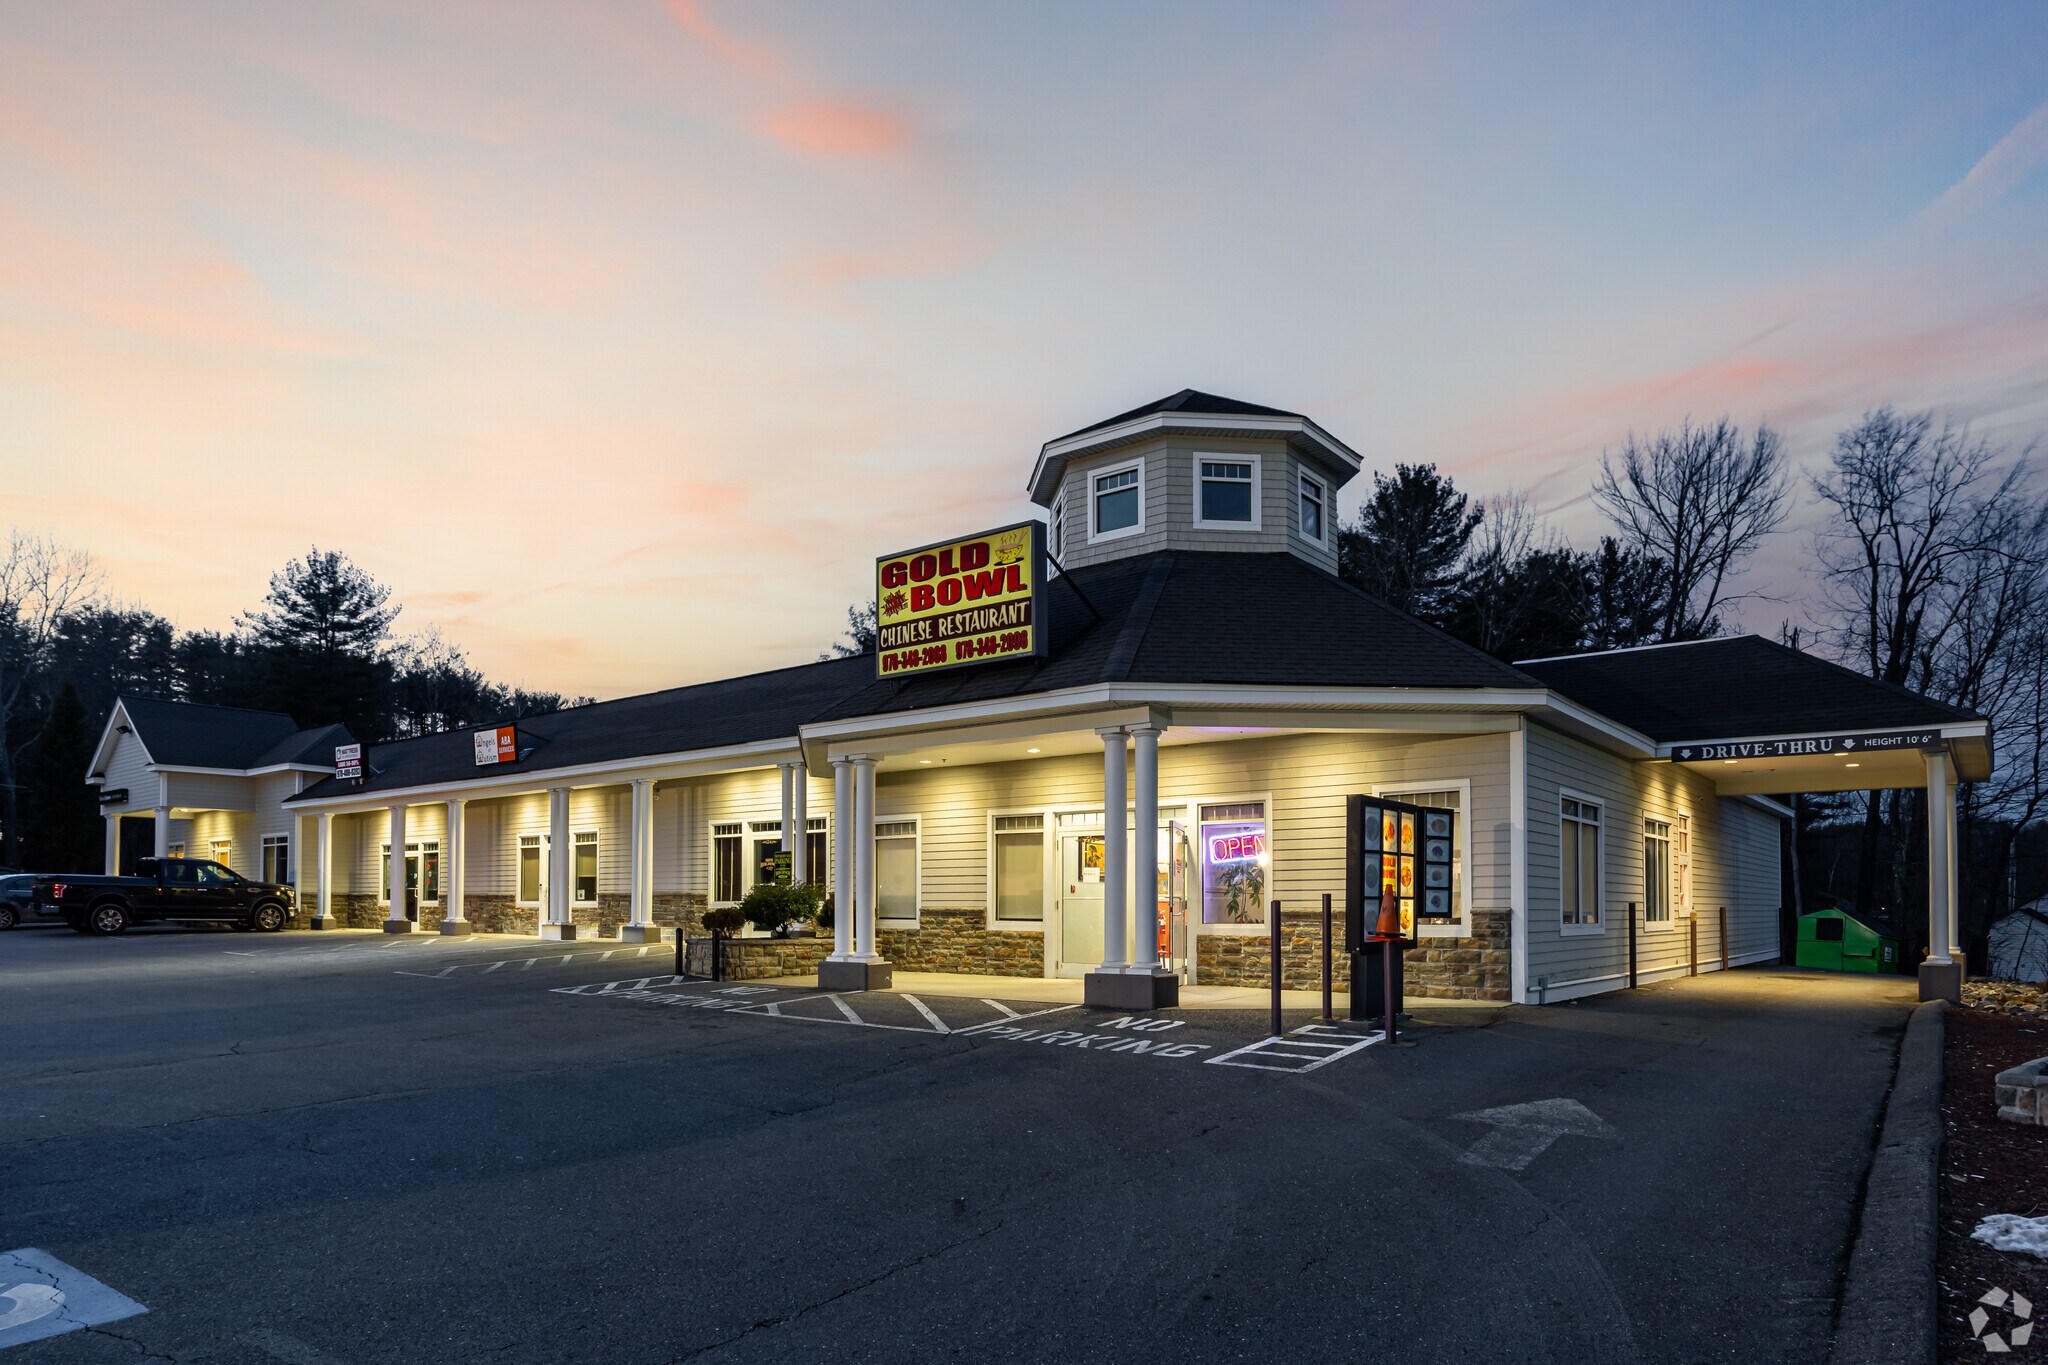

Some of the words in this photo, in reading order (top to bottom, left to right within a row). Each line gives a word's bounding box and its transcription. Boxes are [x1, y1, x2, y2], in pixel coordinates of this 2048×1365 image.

[881, 543, 990, 589] GOLD
[910, 564, 1028, 612] BOWL
[880, 619, 933, 648] CHINESE
[938, 601, 1030, 638] RESTAURANT
[500, 735, 511, 746] ABA
[1701, 738, 1834, 760] DRIVE-THRU
[1864, 736, 1903, 747] HEIGHT
[1095, 1016, 1186, 1032] NO
[963, 1026, 1212, 1058] PARKING
